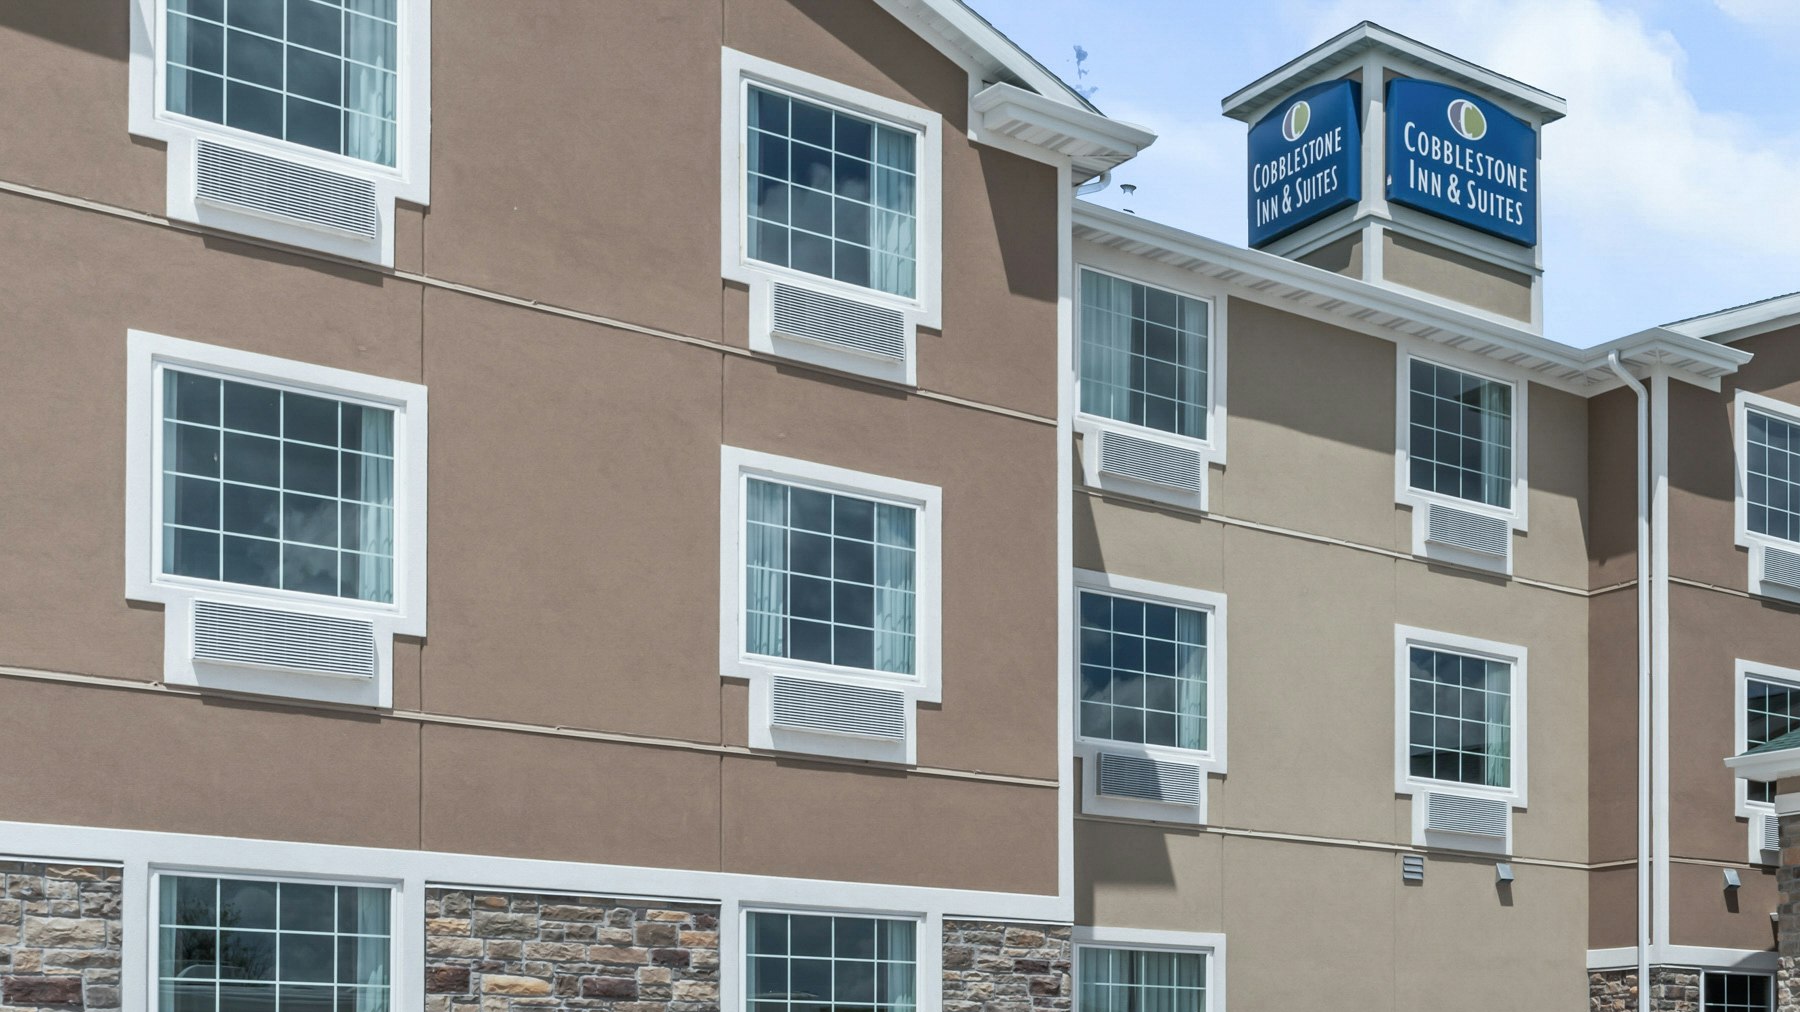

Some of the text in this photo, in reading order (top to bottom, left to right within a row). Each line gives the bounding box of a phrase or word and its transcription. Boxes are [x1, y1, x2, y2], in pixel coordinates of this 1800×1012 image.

[1253, 126, 1342, 193] COBBLESTONE
[1404, 121, 1528, 193] COBBLESTONE
[1257, 165, 1338, 228] INN & SUITES
[1409, 158, 1523, 226] INN & SUITES
